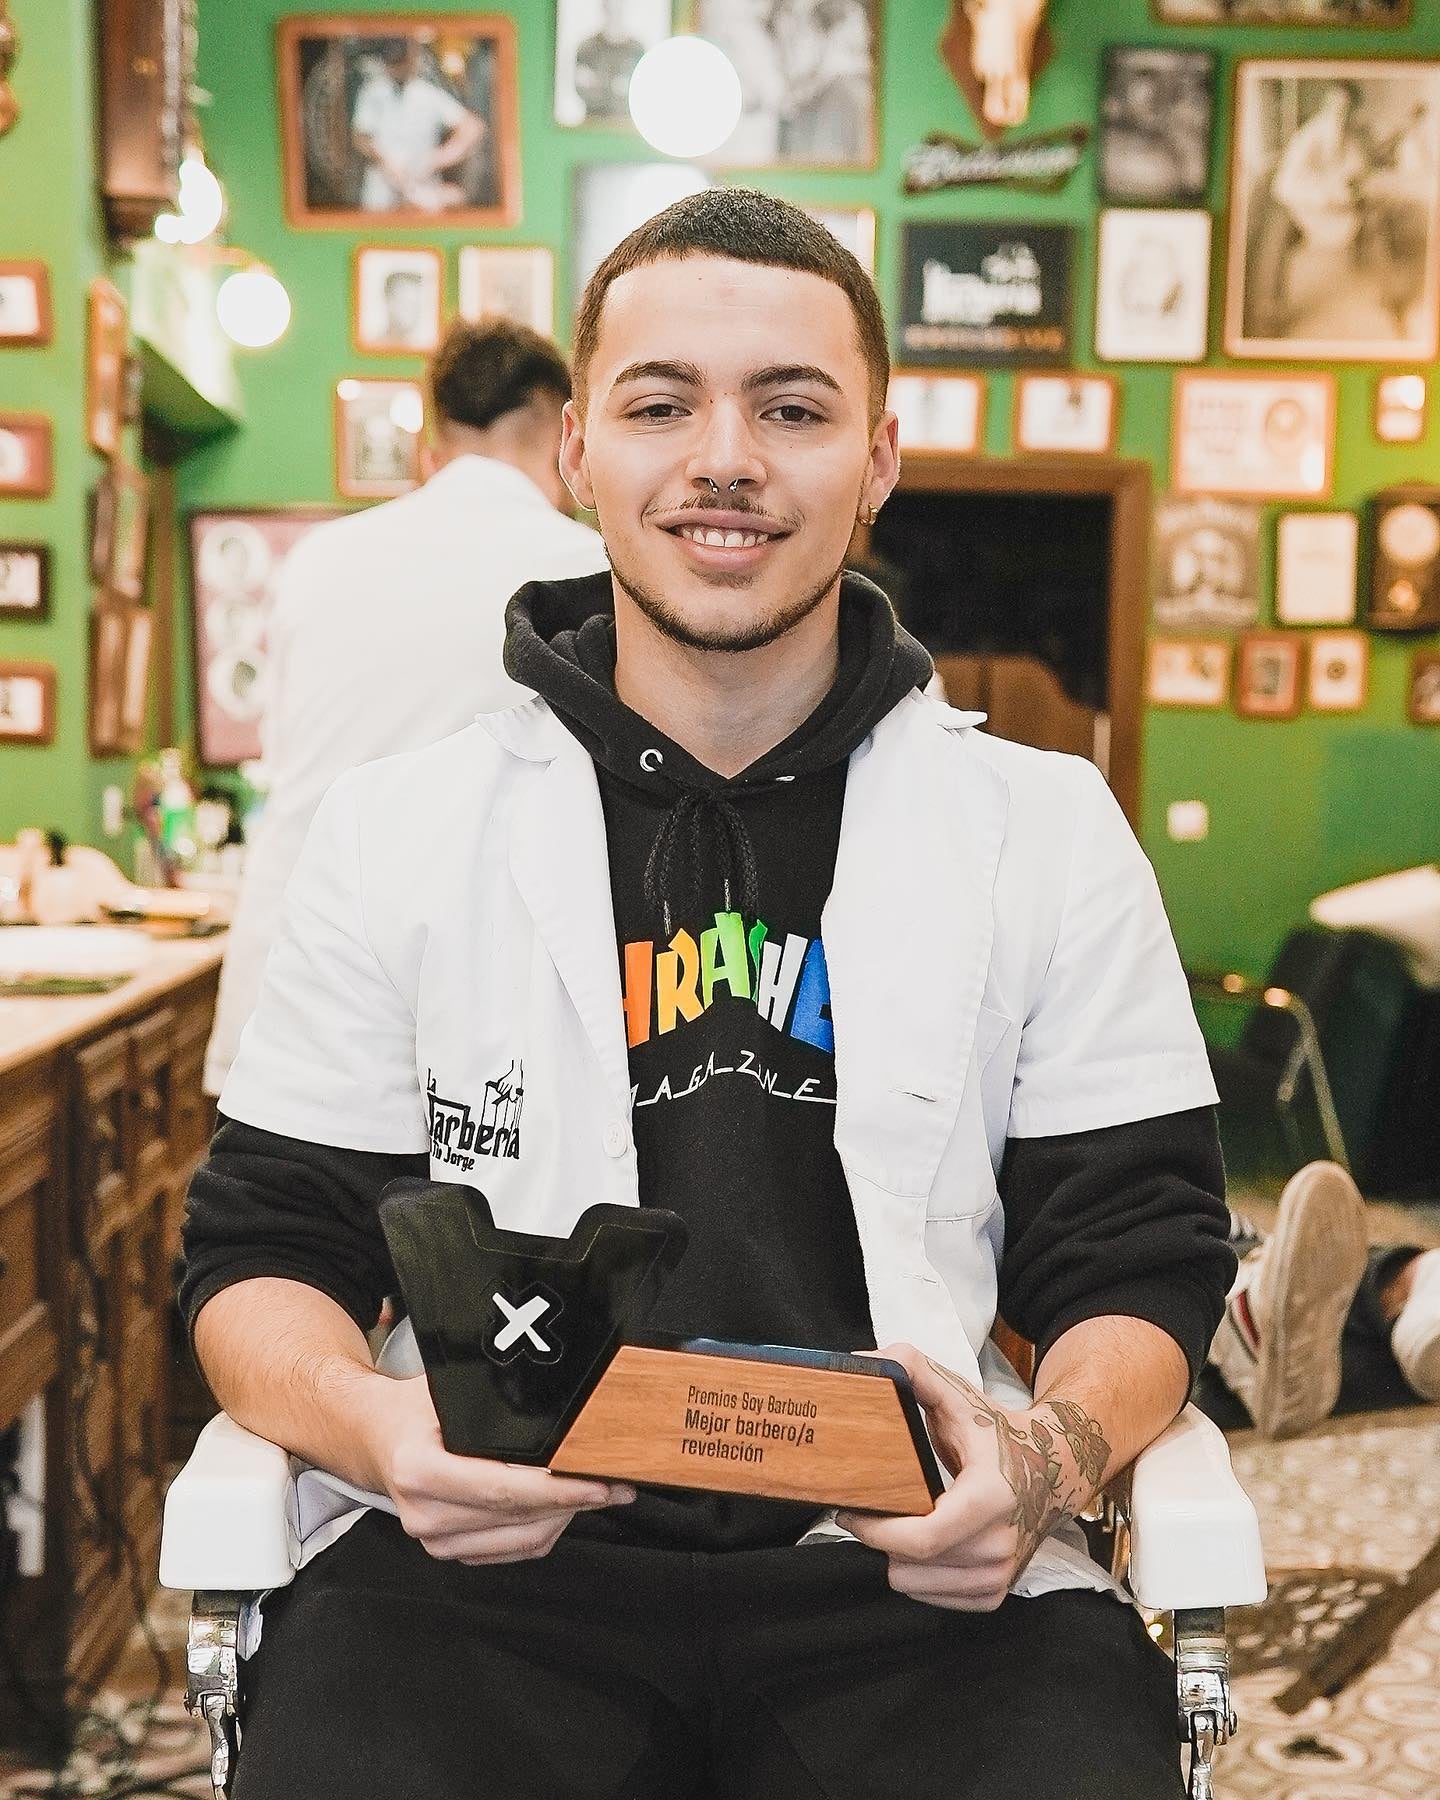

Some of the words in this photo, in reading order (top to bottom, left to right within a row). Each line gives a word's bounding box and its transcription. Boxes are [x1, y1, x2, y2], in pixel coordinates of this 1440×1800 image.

[443, 1146, 475, 1172] Jorge
[688, 1385, 738, 1409] Premios
[741, 1391, 765, 1416] Soy
[767, 1394, 818, 1419] Barbudo
[684, 1407, 731, 1436] Mejor
[735, 1415, 815, 1447] barbero/a
[681, 1437, 764, 1463] revelación
